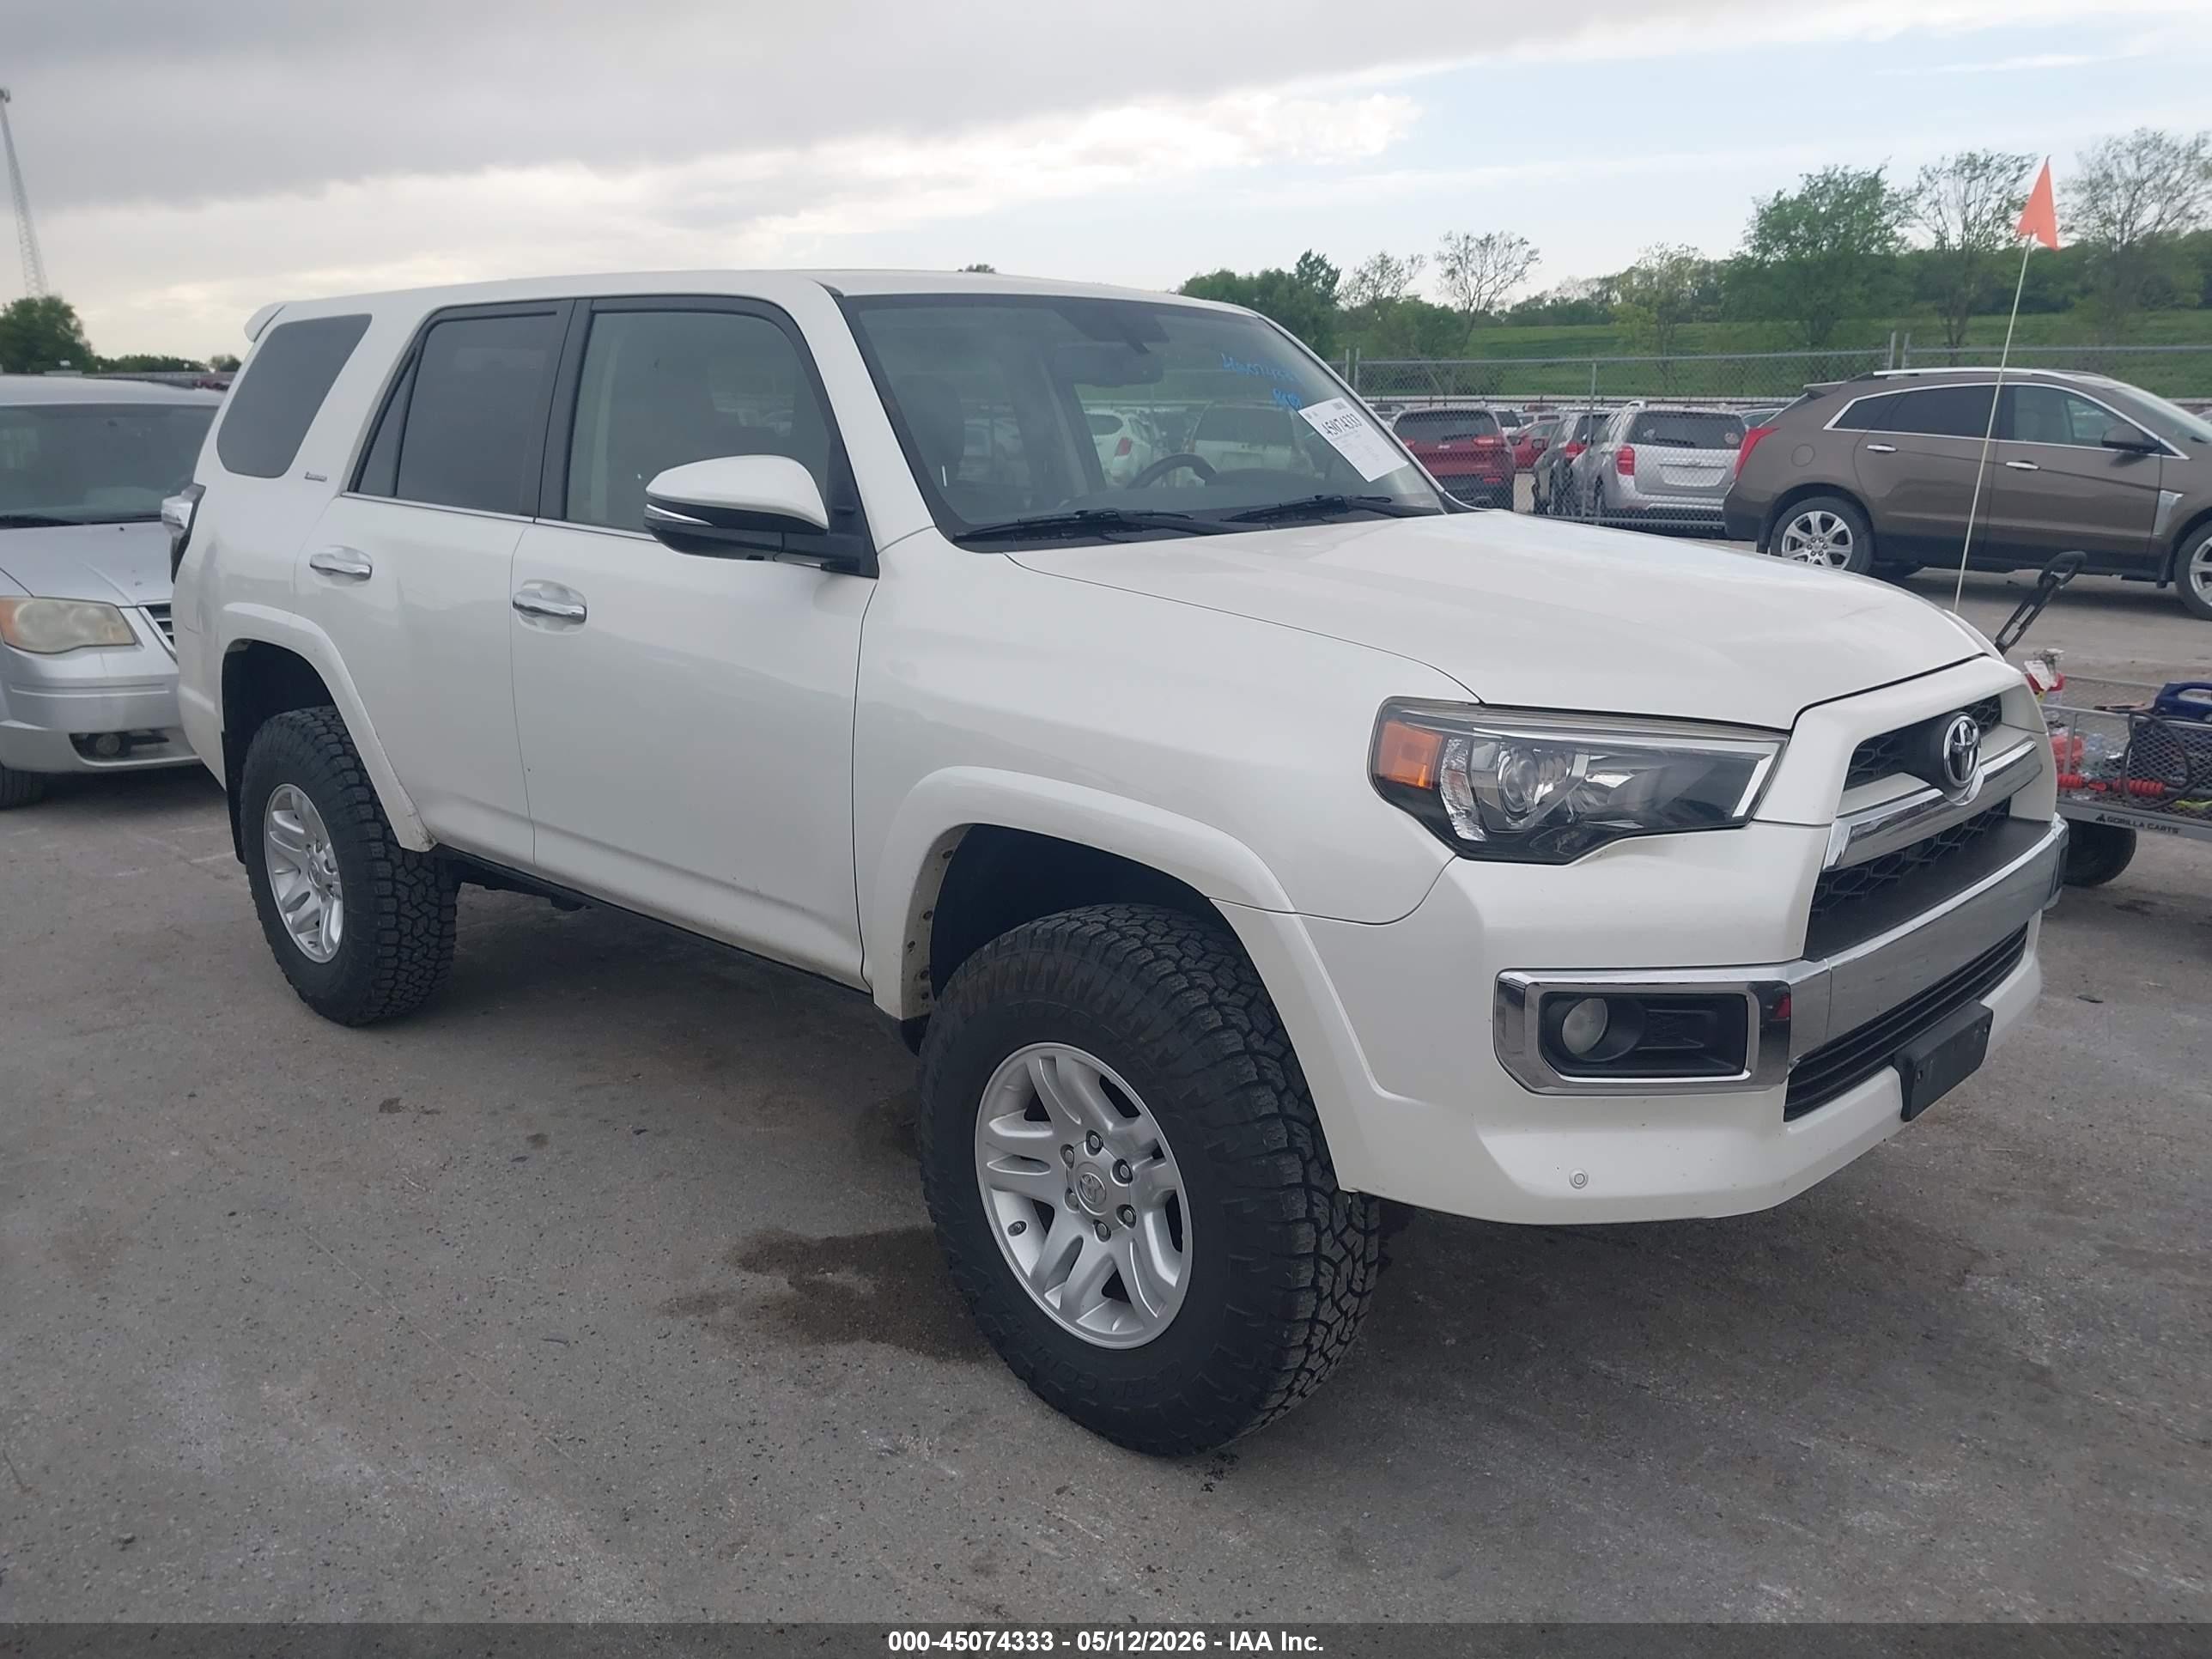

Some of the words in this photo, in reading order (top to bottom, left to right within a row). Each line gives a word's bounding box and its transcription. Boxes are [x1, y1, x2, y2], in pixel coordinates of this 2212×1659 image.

[1322, 413, 1363, 436] 45074333
[2106, 816, 2145, 829] GORILLA
[2148, 823, 2179, 835] CARTS
